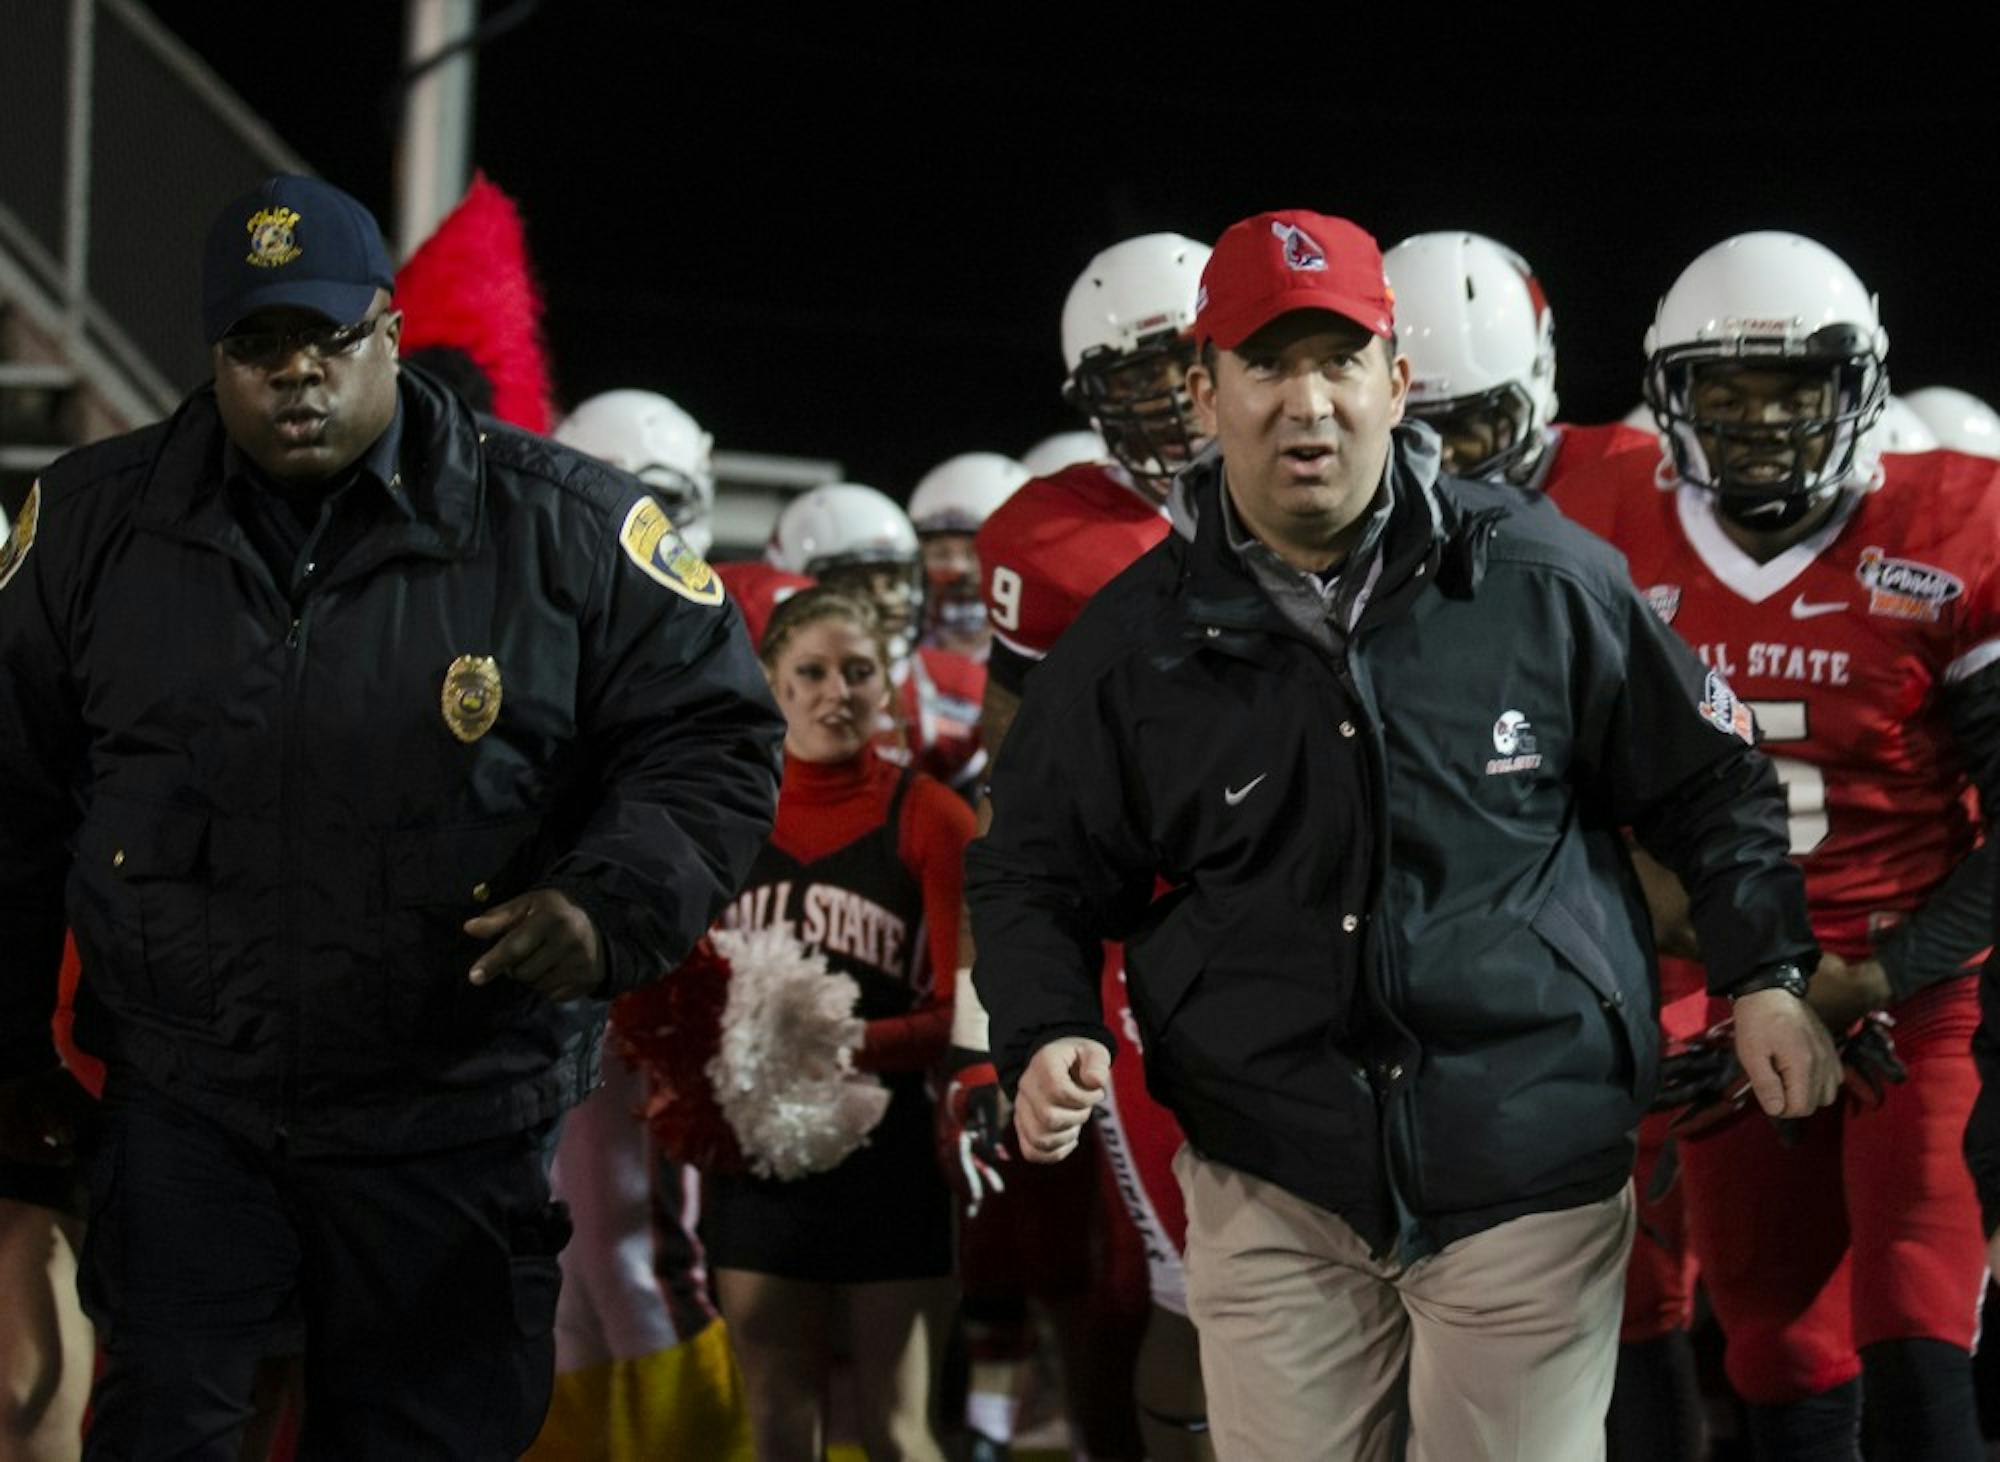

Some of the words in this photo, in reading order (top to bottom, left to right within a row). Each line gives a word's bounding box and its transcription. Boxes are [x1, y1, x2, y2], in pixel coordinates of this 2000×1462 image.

[991, 565, 1022, 631] 9
[1747, 642, 1850, 687] STATE
[803, 883, 905, 978] STATE
[1094, 1100, 1167, 1263] ARDINALS
